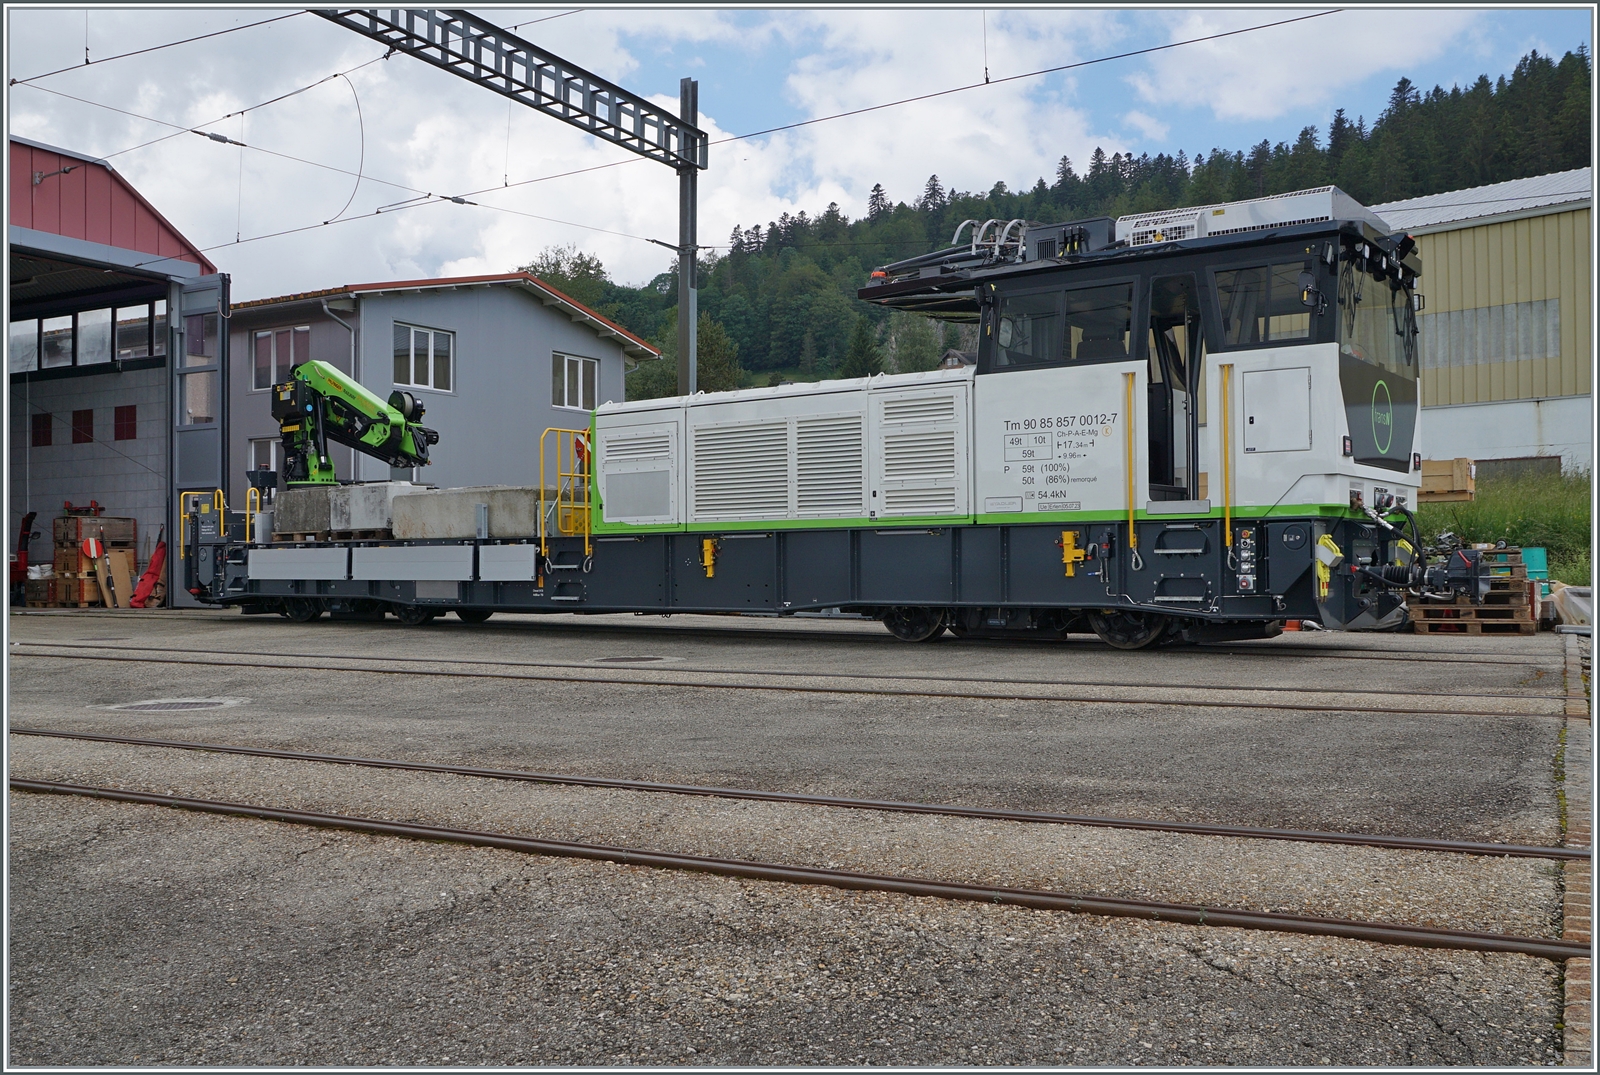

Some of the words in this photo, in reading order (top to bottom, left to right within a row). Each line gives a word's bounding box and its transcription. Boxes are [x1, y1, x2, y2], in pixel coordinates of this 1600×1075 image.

[1004, 420, 1020, 431] Tm
[1023, 419, 1037, 430] 90
[1039, 417, 1053, 428] 85
[1056, 416, 1076, 427] 857
[1079, 413, 1118, 426] 0012-7
[1009, 437, 1022, 446] 49t
[1033, 436, 1046, 444] 10t
[1022, 449, 1035, 458] 59t
[1003, 466, 1010, 474] P
[1022, 465, 1035, 473] 59t
[1040, 463, 1070, 474] (100%)
[1022, 476, 1035, 485] 50t
[1045, 475, 1070, 485] (86%)
[1037, 490, 1067, 499] 54.4kN
